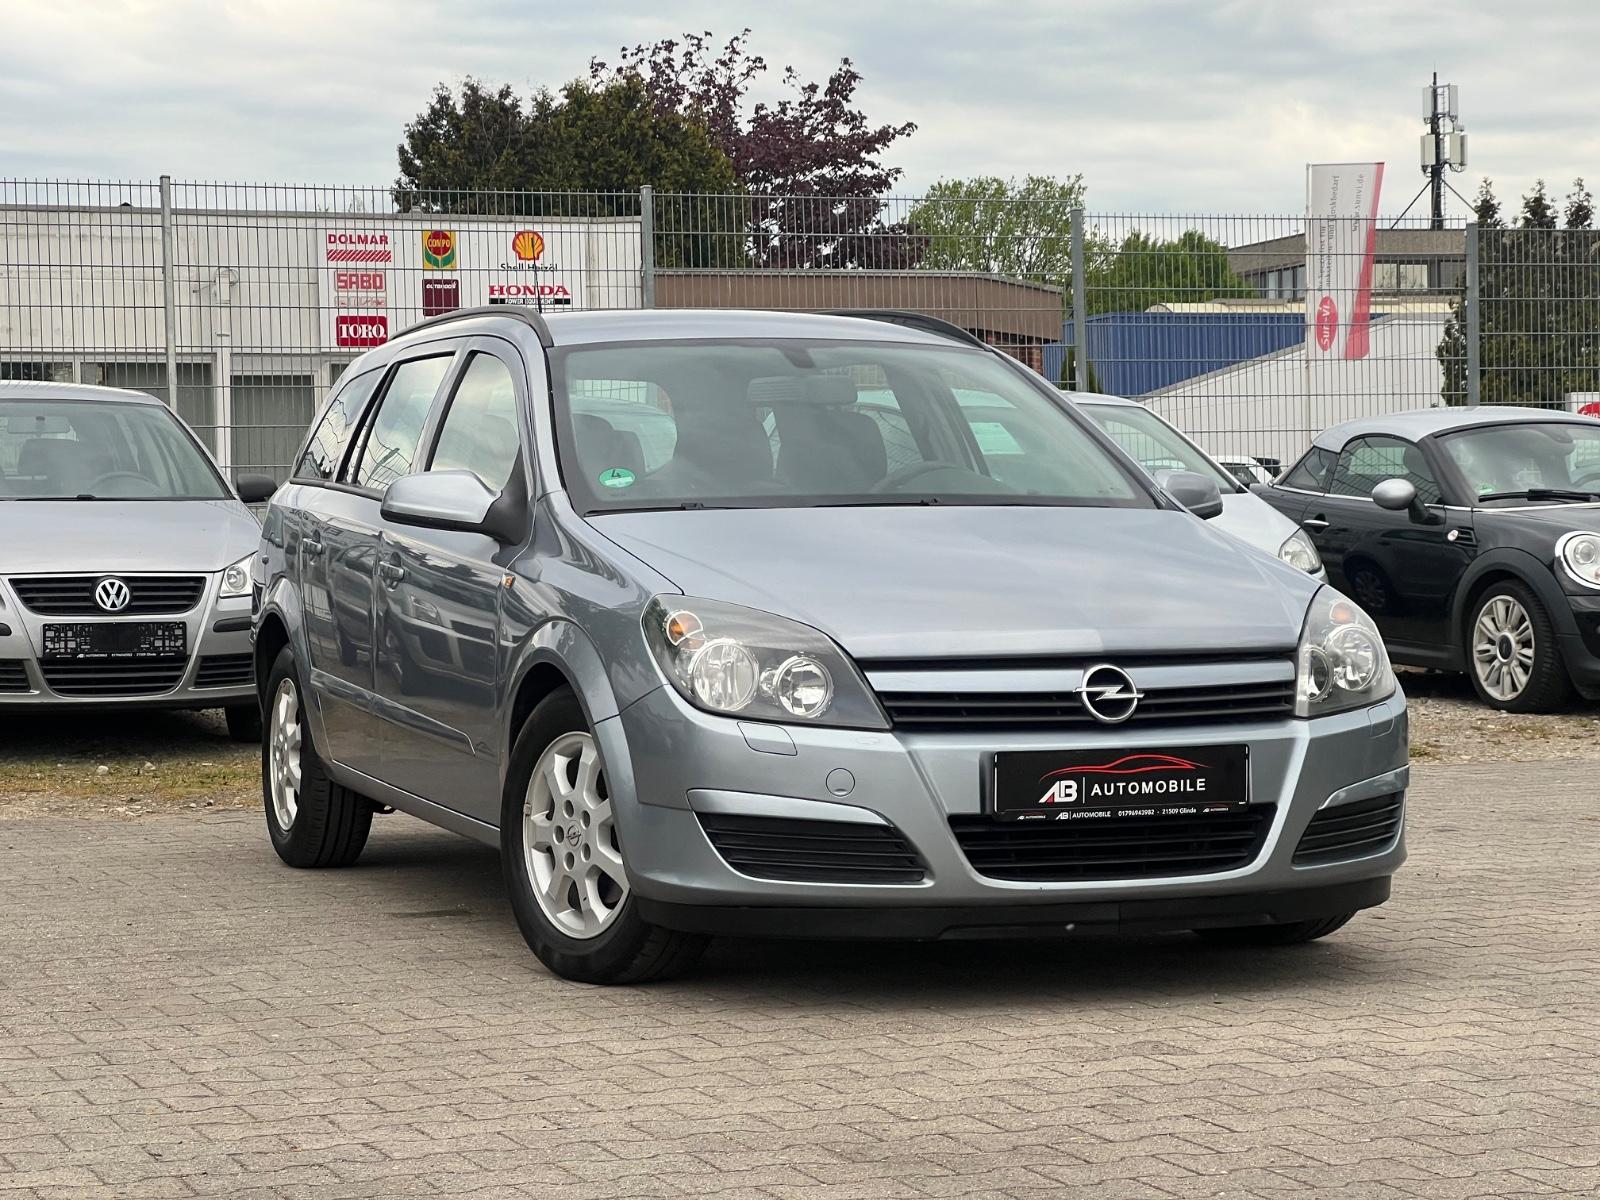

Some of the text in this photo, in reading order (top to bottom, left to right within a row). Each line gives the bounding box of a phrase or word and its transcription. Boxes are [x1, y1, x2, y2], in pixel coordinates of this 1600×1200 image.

[328, 234, 389, 245] DOLMAR
[336, 273, 383, 290] SABO
[488, 285, 570, 296] HONDA
[339, 324, 385, 338] TORO
[1090, 778, 1206, 797] AUTOMOBILE
[1072, 810, 1111, 818] AUTOMOBILE
